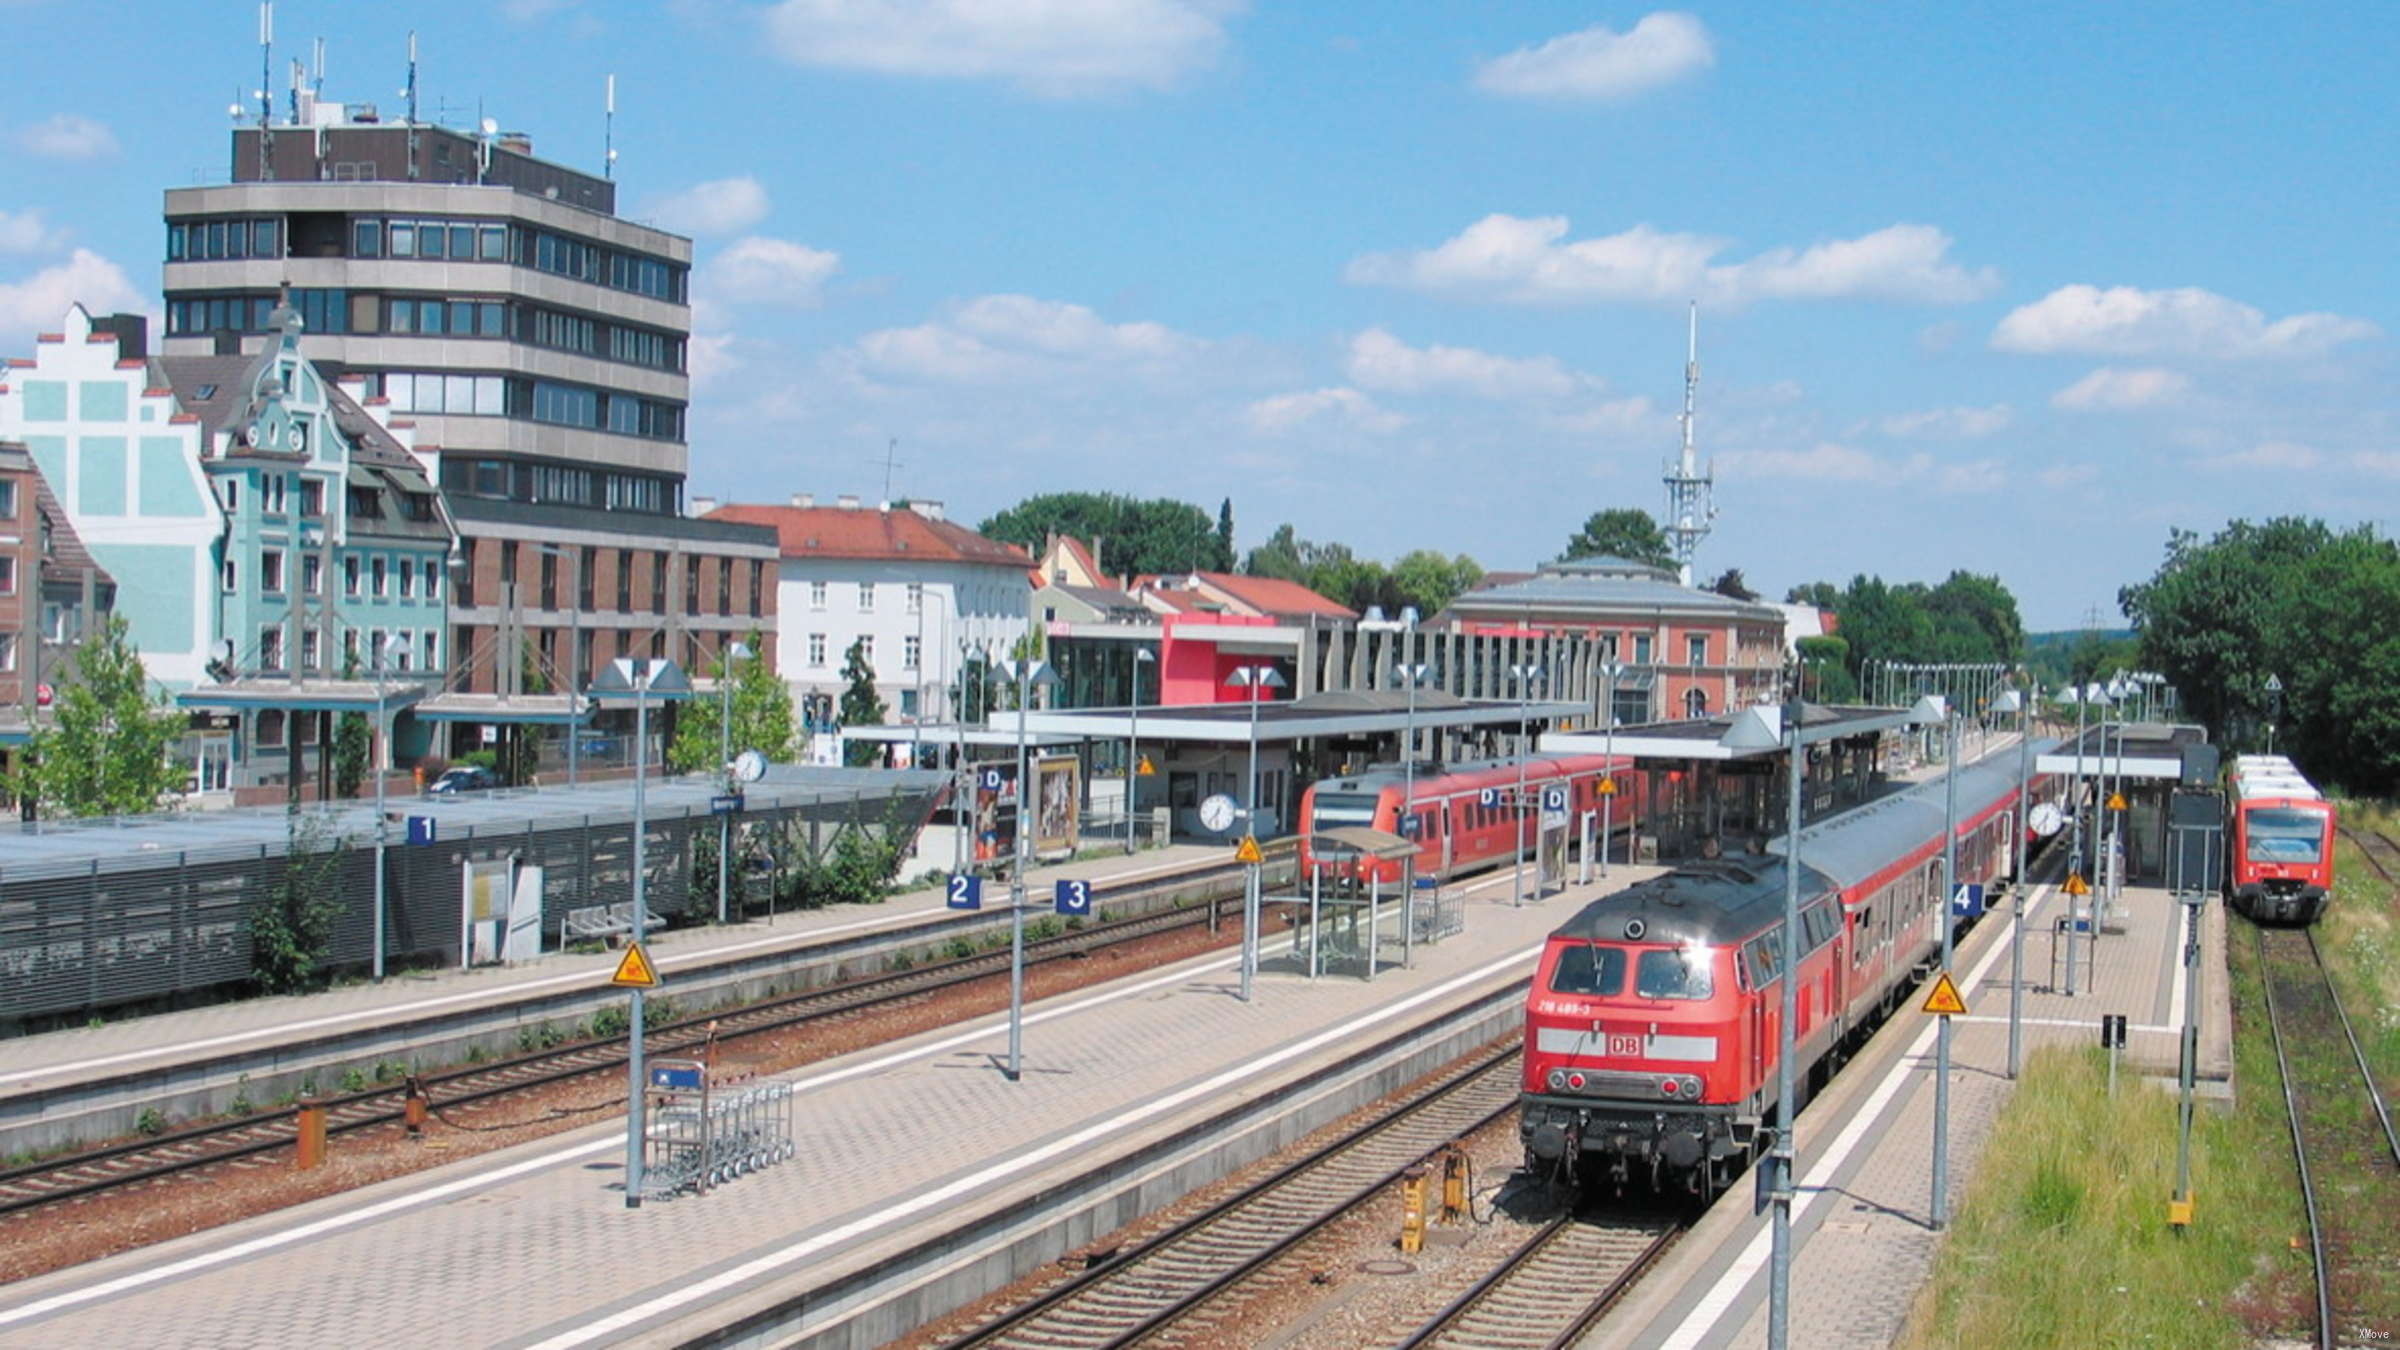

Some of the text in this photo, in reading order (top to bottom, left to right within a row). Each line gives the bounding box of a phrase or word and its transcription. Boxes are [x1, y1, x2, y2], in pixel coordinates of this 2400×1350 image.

[1481, 788, 1493, 805] D
[1549, 790, 1561, 807] D
[421, 818, 431, 840] 1
[951, 875, 968, 903] 2
[1068, 881, 1085, 908] 3
[1954, 884, 1971, 910] 4
[1613, 1038, 1636, 1053] DB
